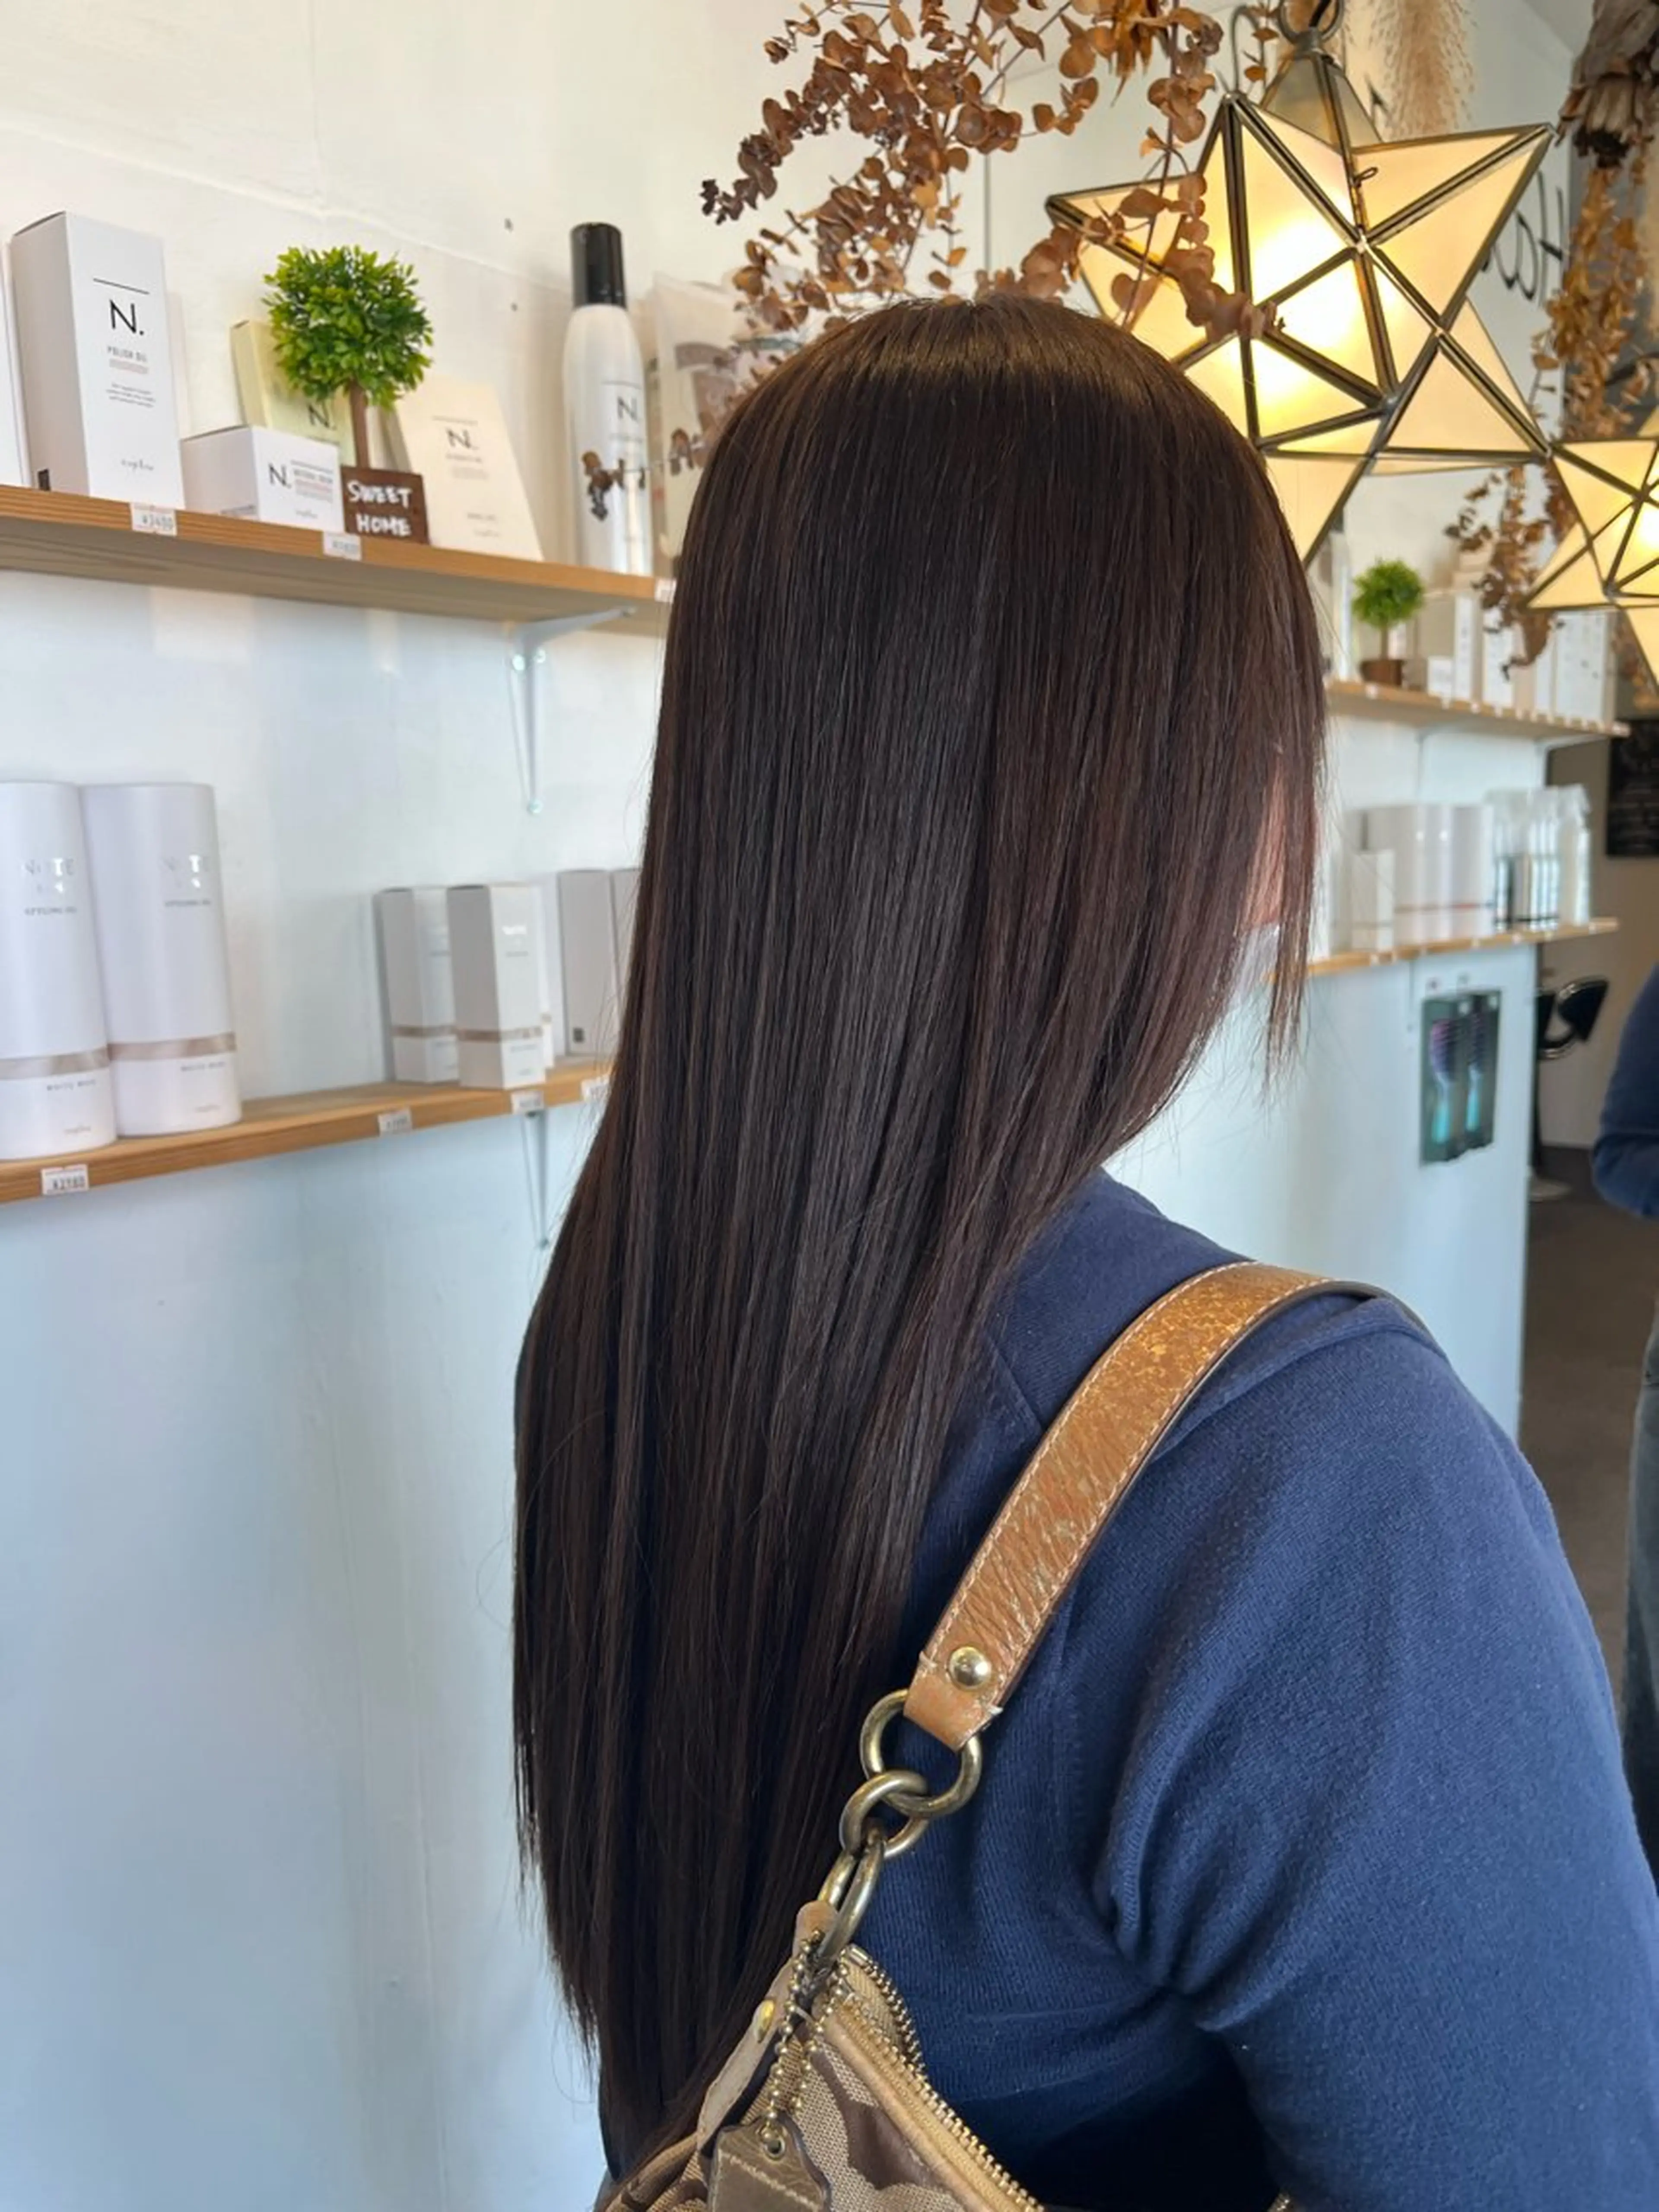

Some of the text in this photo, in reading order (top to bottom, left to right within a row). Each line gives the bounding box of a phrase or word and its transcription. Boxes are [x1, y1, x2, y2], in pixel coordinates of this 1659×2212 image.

[109, 299, 144, 336] N.
[268, 462, 292, 489] N.
[347, 480, 413, 508] SWEET
[356, 511, 412, 538] HOME
